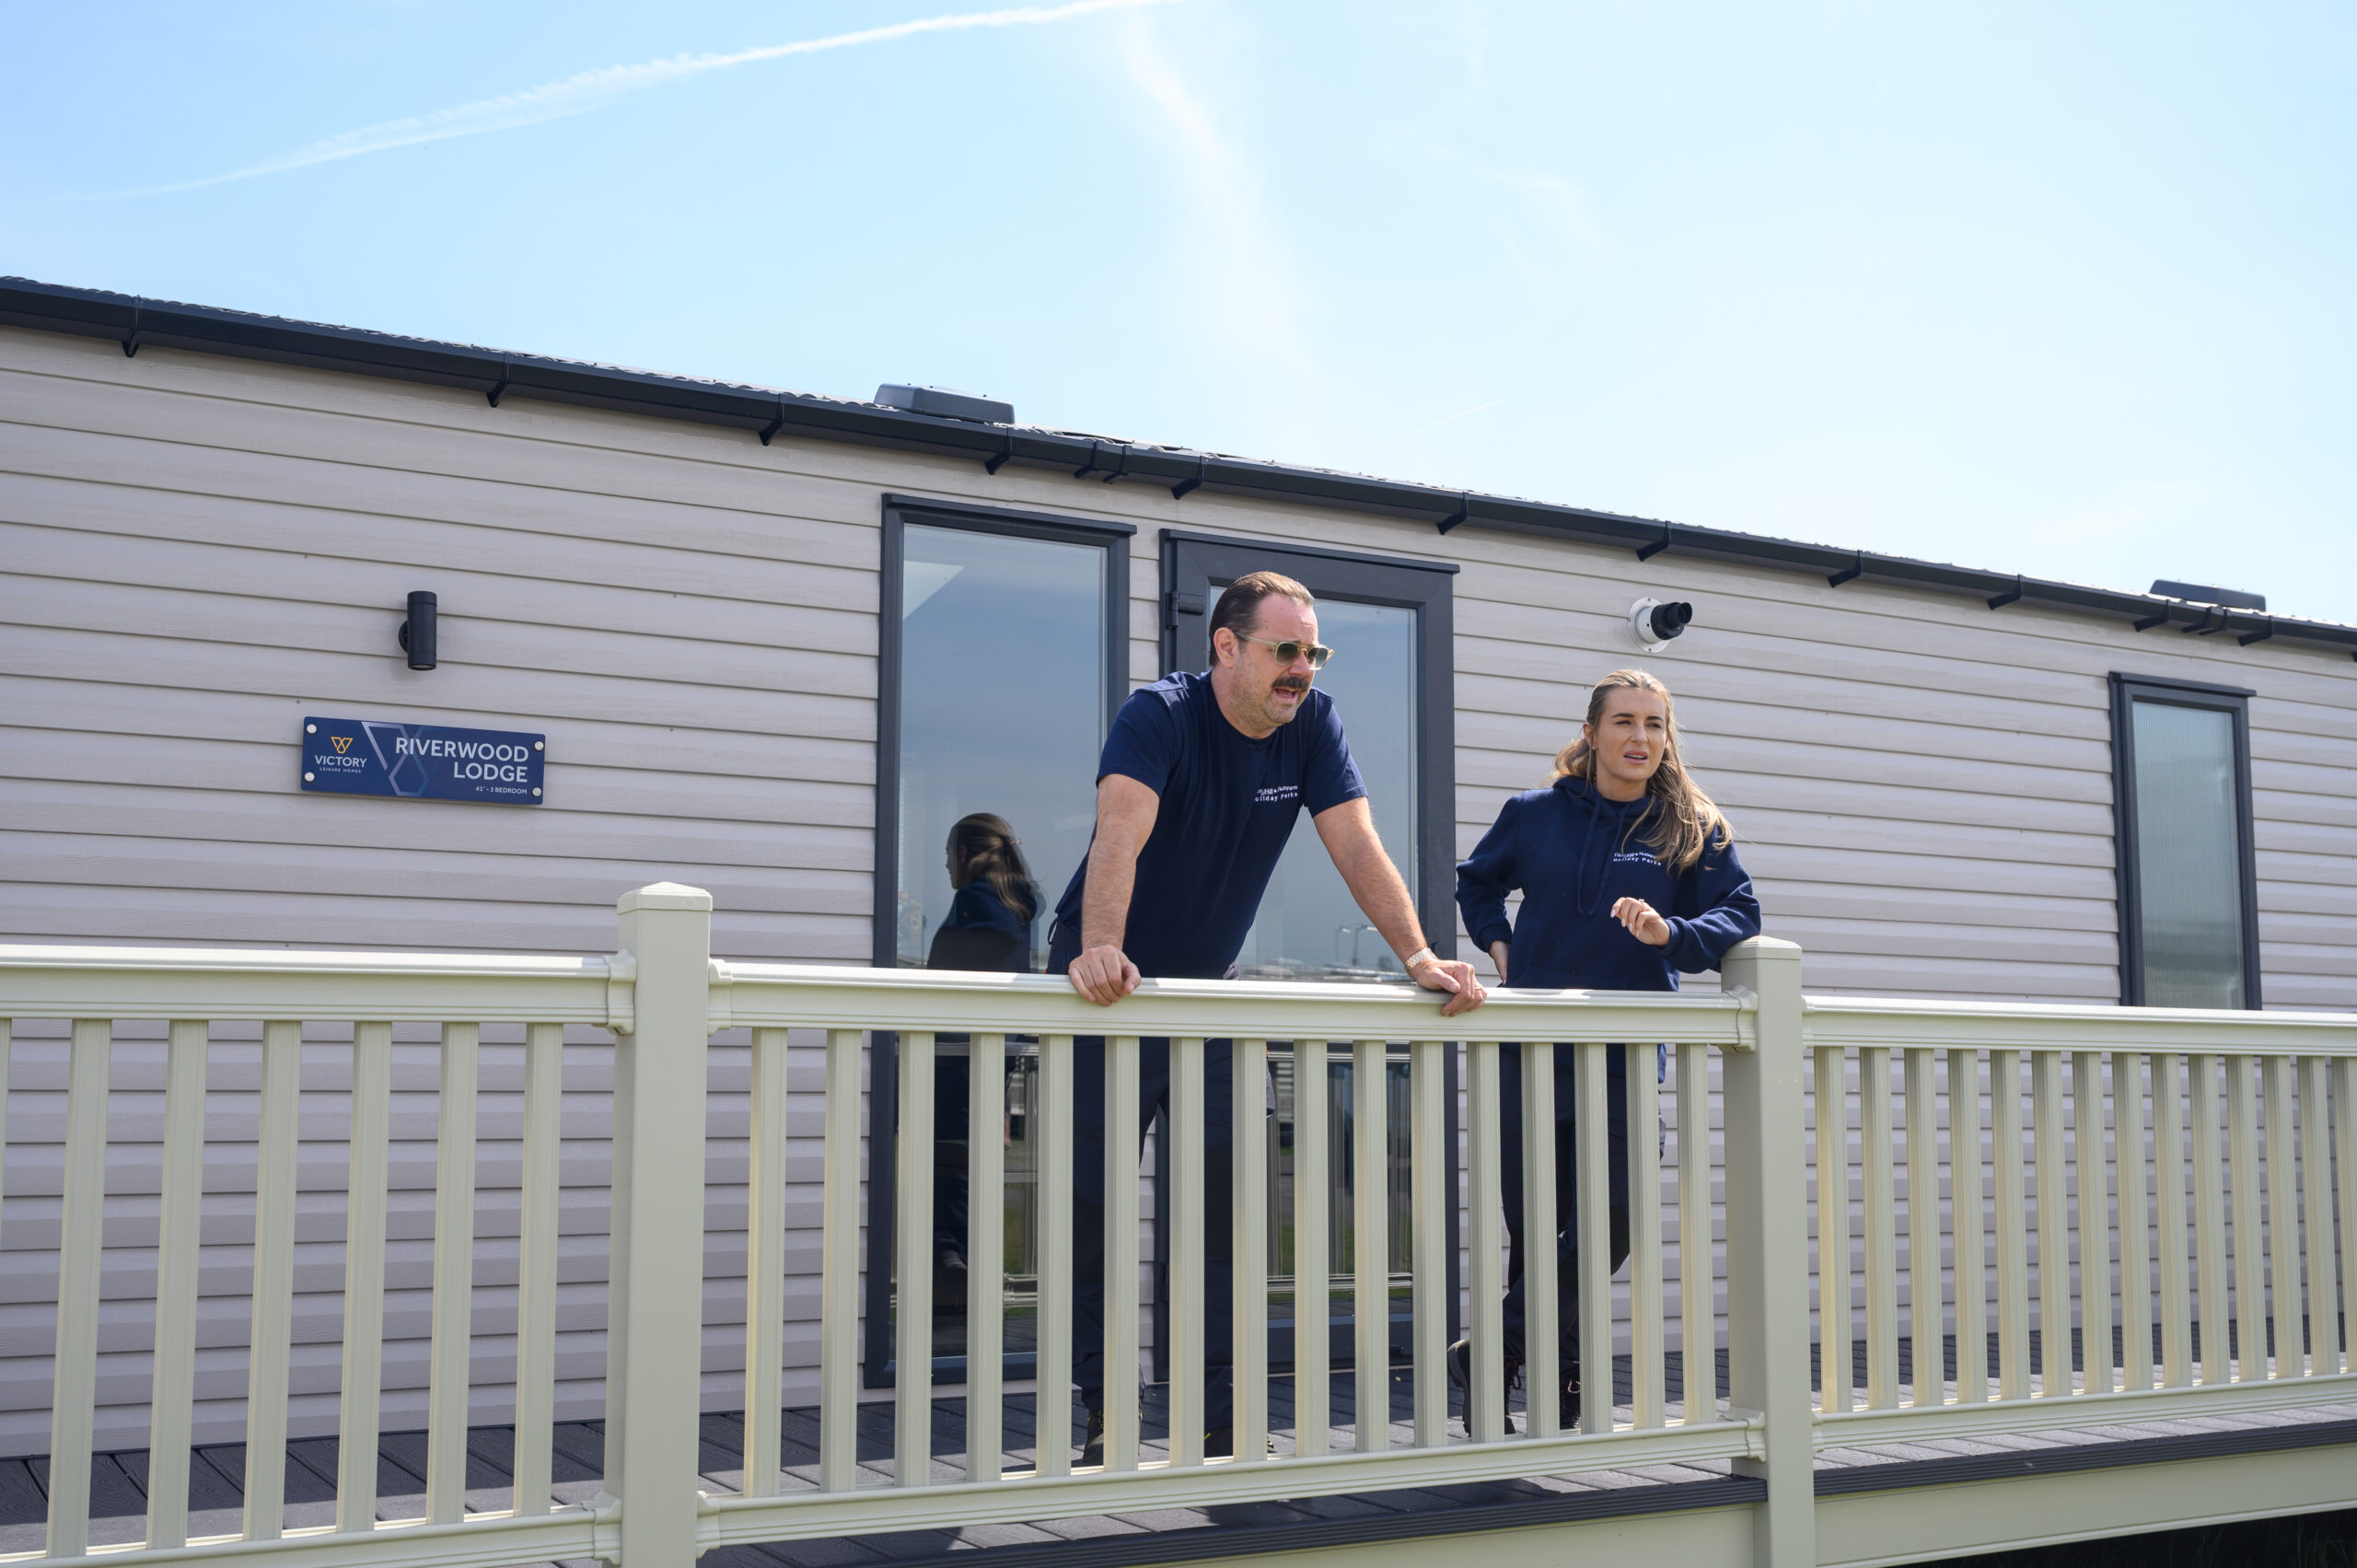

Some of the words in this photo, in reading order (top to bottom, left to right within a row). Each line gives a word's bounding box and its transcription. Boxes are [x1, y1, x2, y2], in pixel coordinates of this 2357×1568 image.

[395, 737, 529, 762] RIVERWOOD
[315, 754, 367, 768] VICTORY
[454, 761, 528, 783] LODGE
[494, 786, 528, 795] BEDROOM
